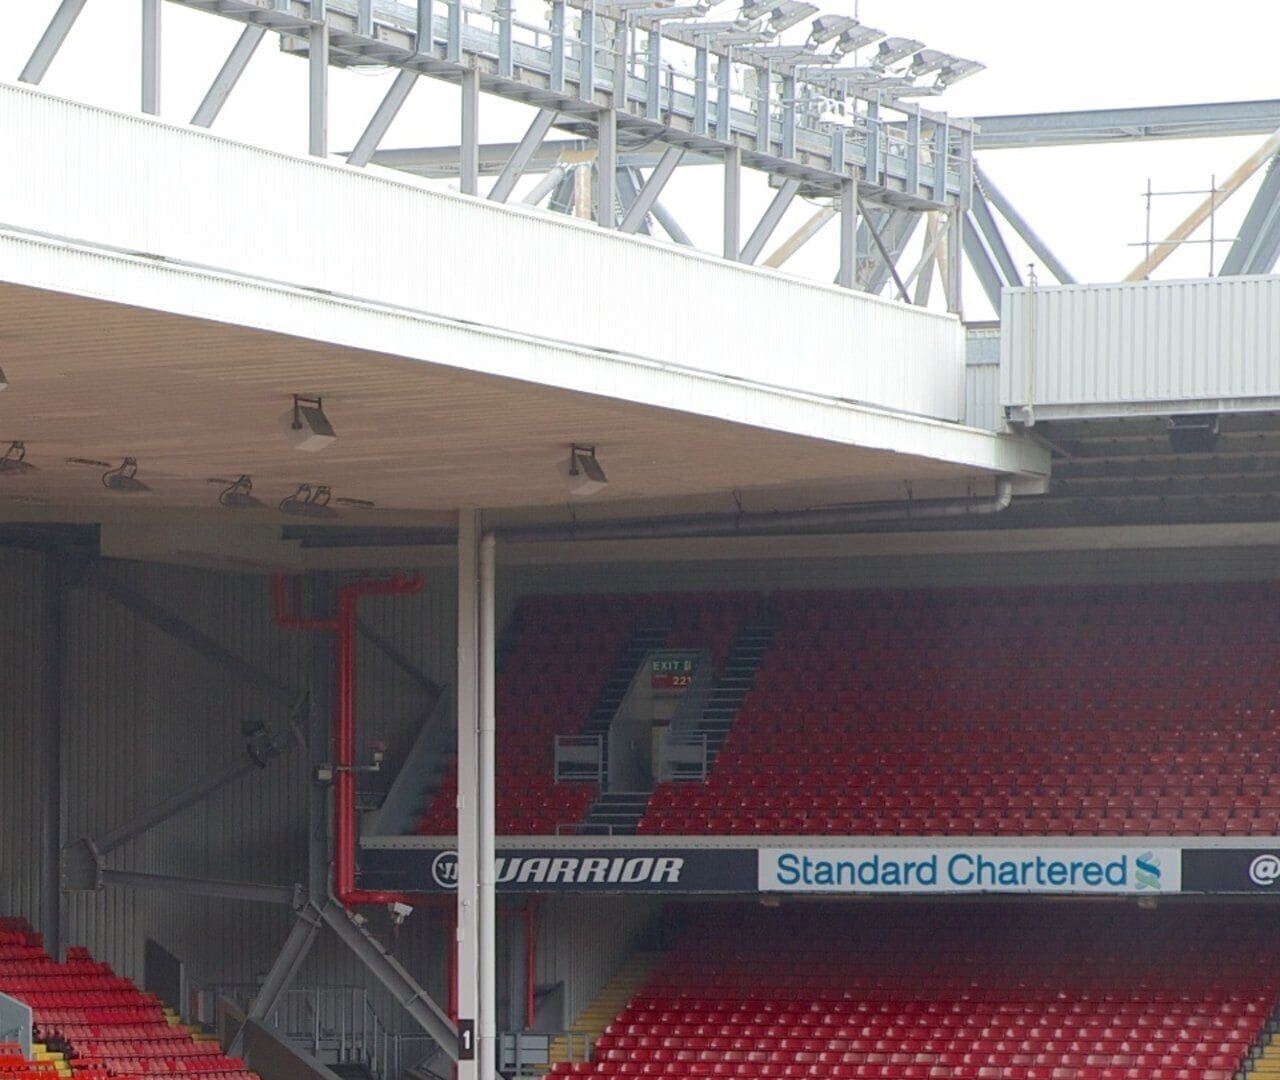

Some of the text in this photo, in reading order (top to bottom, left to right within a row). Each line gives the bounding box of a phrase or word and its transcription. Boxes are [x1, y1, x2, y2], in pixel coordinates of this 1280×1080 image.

[653, 661, 680, 671] EXIT
[777, 853, 1126, 887] Standard Chartered
[463, 1030, 470, 1049] 1
